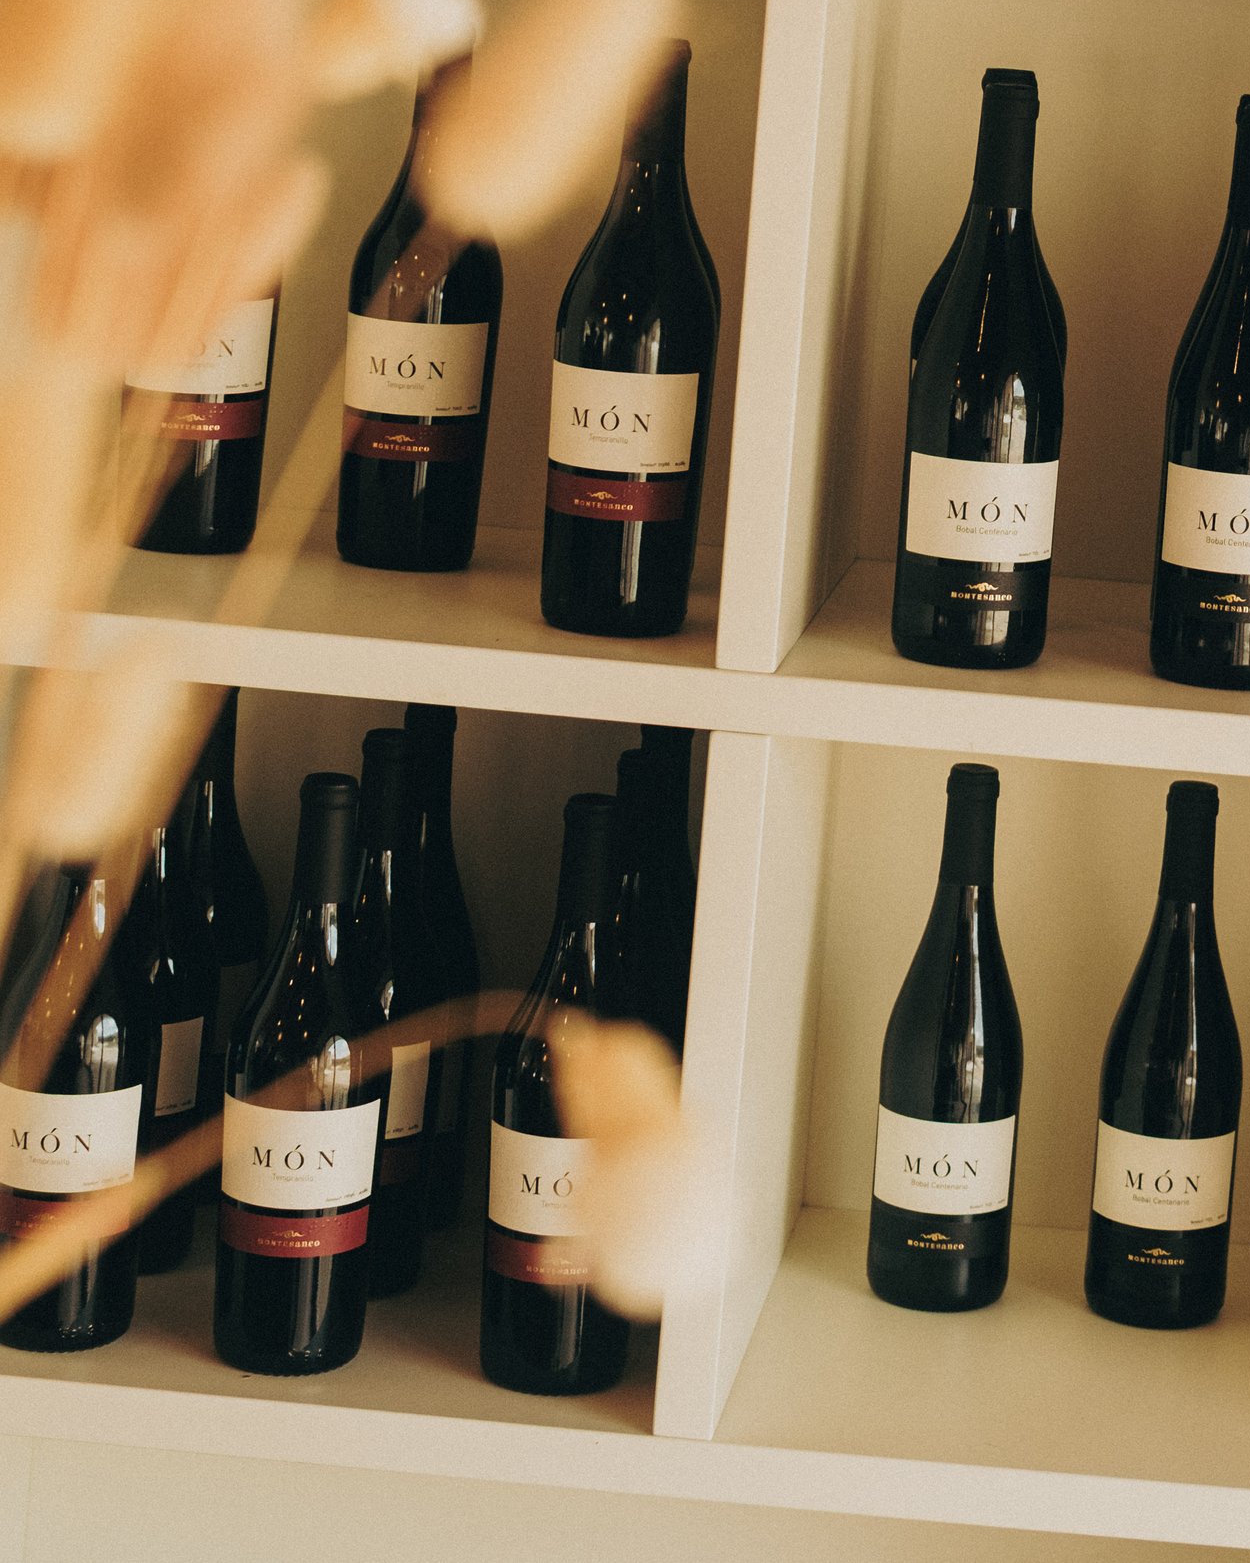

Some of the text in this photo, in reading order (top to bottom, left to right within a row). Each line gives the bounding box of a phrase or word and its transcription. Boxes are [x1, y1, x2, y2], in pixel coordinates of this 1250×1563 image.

[369, 354, 446, 380] MÓN
[571, 405, 652, 434] MÓN
[946, 496, 1029, 523] MÓN
[955, 524, 1019, 537] Bobal Centenario
[1205, 535, 1227, 546] Bobal
[10, 1127, 93, 1155] MÓN
[251, 1144, 336, 1171] MÓN
[903, 1153, 979, 1179] MÓN
[519, 1171, 574, 1199] MÓ
[1124, 1169, 1200, 1194] MÓN
